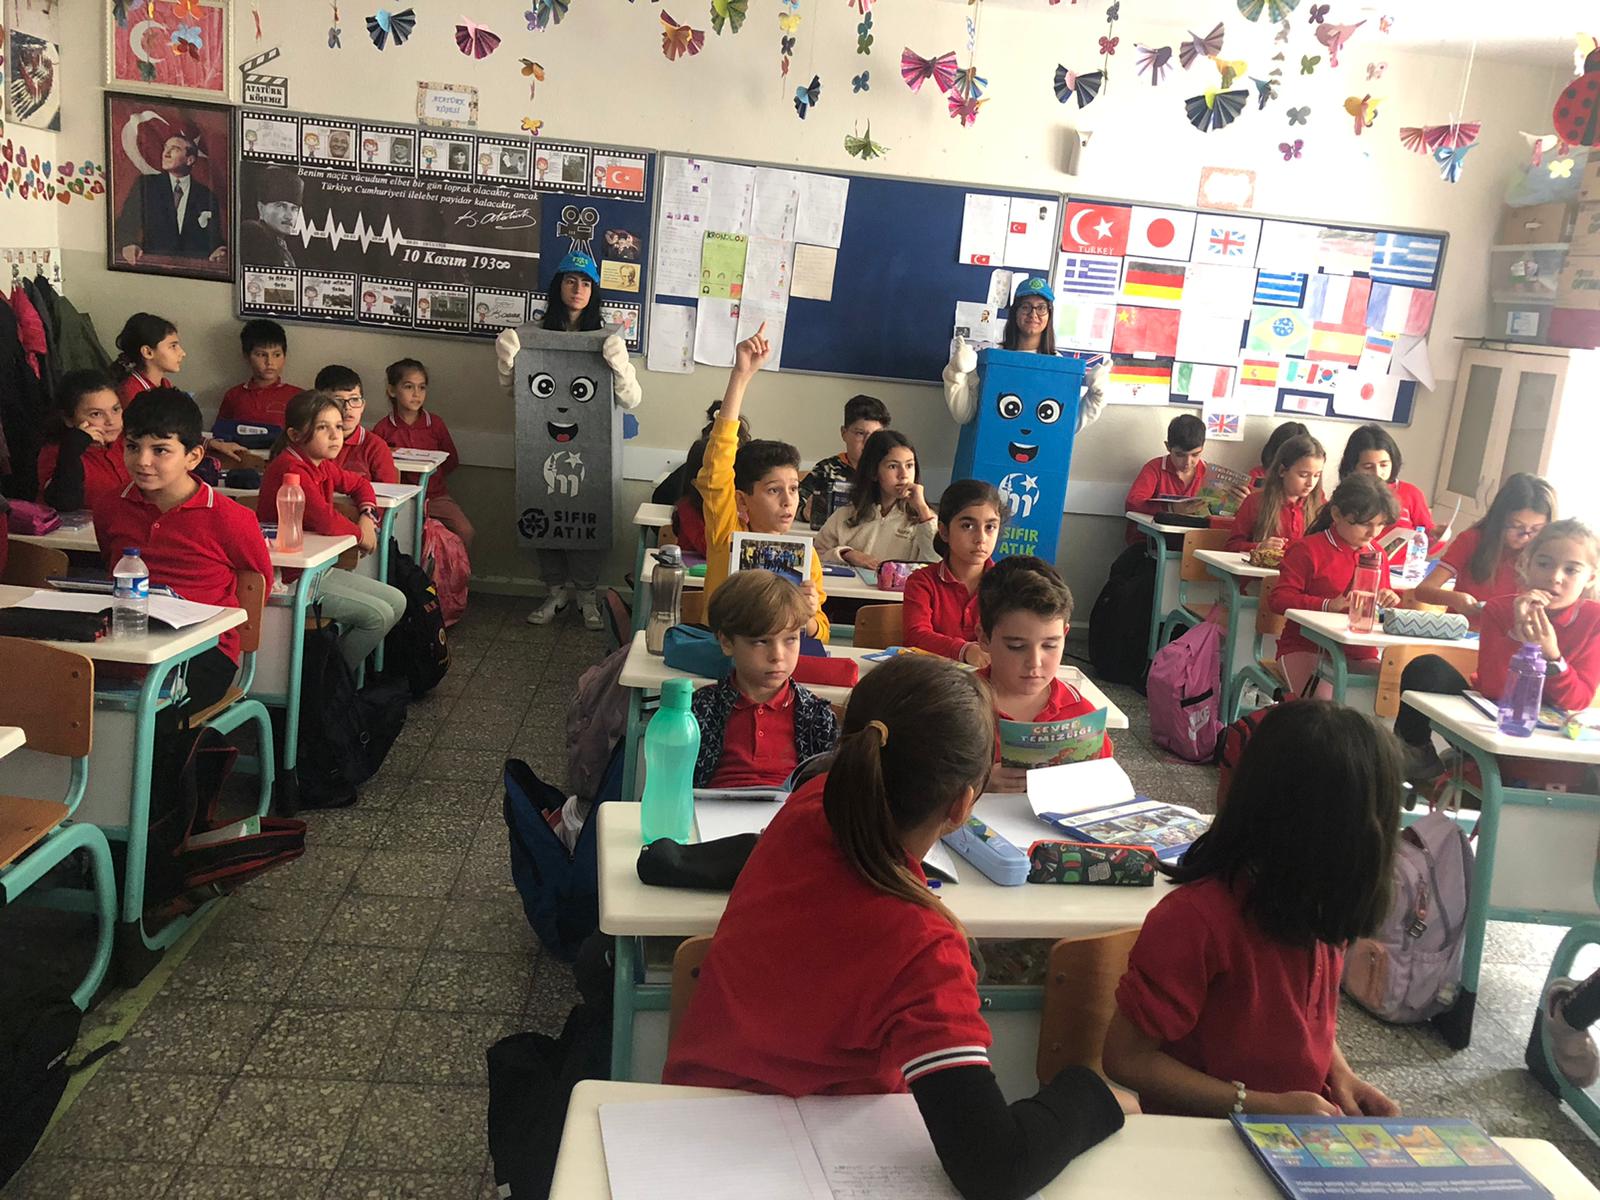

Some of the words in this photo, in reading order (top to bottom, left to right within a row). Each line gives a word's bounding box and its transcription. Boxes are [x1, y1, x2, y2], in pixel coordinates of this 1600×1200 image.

[246, 84, 283, 95] ATATÜRK
[297, 168, 324, 178] Benim
[326, 171, 348, 181] naçiz
[351, 175, 387, 185] vücudum
[390, 177, 410, 187] elbet
[412, 179, 424, 188] bir
[426, 181, 442, 191] gün
[444, 183, 471, 194] toprak
[513, 192, 539, 201] ancak
[321, 182, 353, 194] Türkiye
[354, 185, 407, 199] Cumhuriyeti
[408, 190, 439, 201] ilelebet
[440, 194, 472, 205] payidar
[1078, 245, 1114, 256] TURKEY
[402, 249, 420, 263] 10
[423, 250, 468, 268] Kasım
[554, 511, 597, 524] SIFIR
[553, 526, 597, 540] ATIK
[1004, 527, 1038, 541] SIFIR
[1000, 542, 1036, 556] ATIK
[1189, 706, 1210, 731] NIKE
